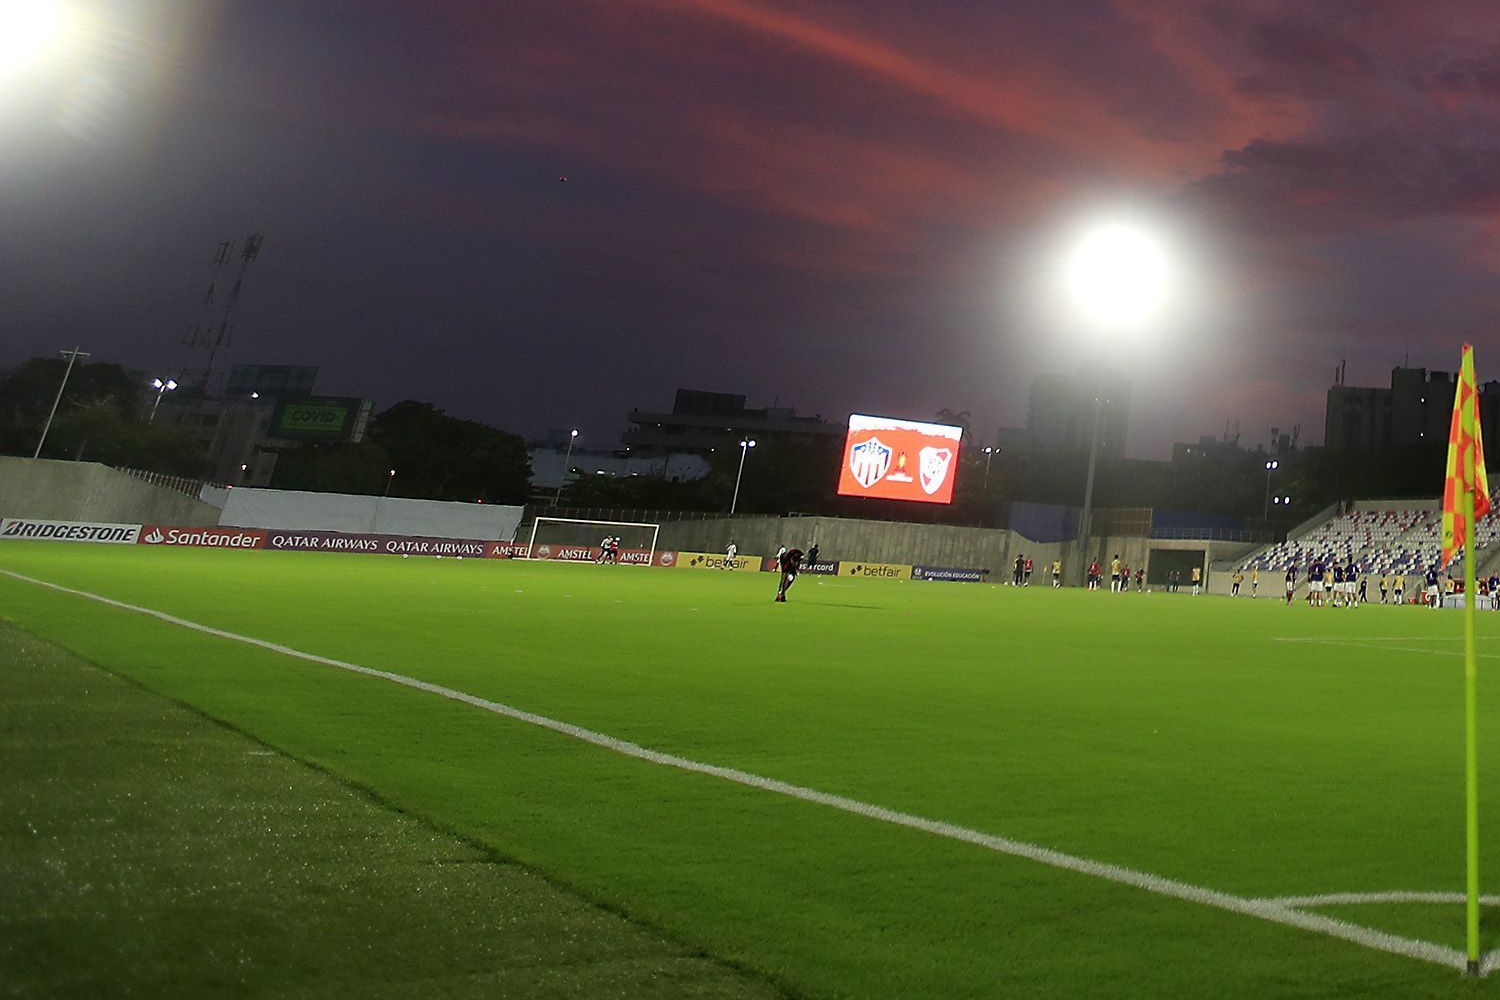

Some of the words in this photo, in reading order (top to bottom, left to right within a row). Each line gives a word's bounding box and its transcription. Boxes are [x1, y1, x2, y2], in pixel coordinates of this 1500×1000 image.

[2, 521, 136, 541] BRIDGESTONE
[166, 530, 260, 547] Santander
[272, 535, 319, 548] QATAR
[321, 538, 378, 550] AIRWAYS
[386, 540, 429, 553] QATAR
[431, 542, 484, 554] AIRWAYS
[557, 549, 592, 560] AMSTEL
[620, 552, 650, 563] AMSTE
[705, 555, 748, 569] betair
[863, 565, 901, 577] betfair
[924, 570, 952, 578] EVOLUCIÓN
